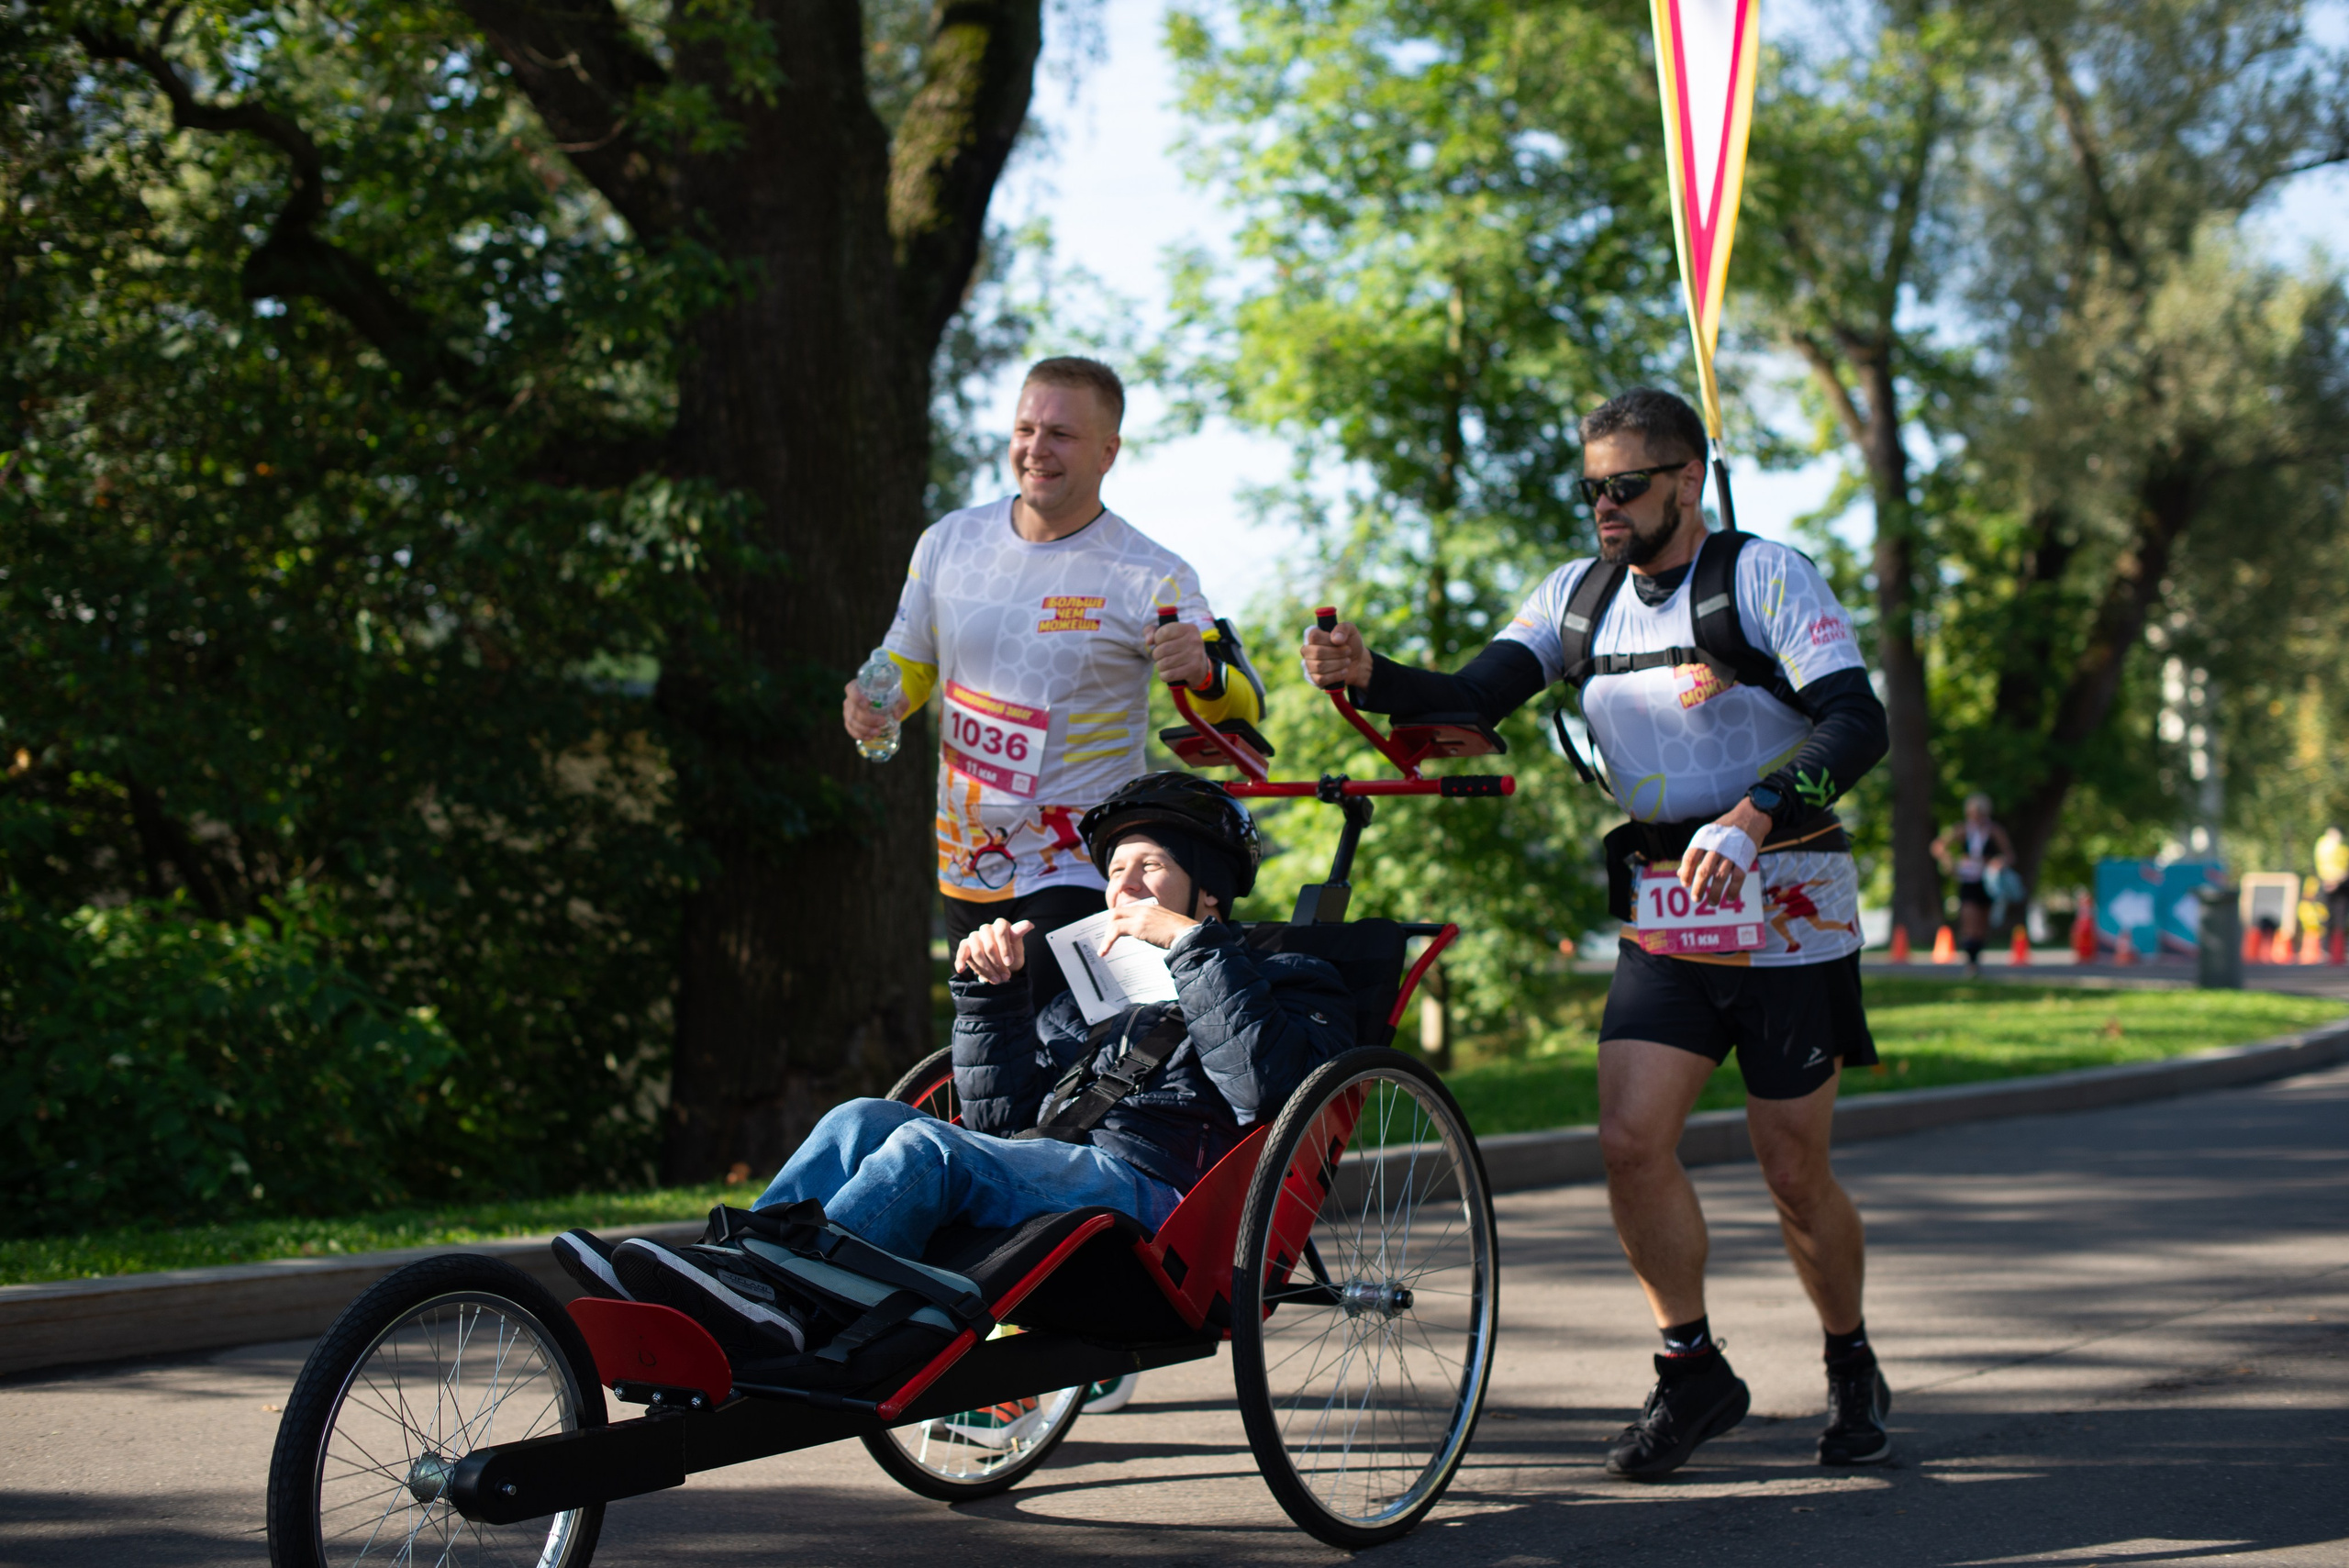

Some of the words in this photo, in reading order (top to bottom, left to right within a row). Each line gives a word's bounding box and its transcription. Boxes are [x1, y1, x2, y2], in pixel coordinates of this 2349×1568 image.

[1048, 596, 1105, 608] БОЛЬШЕ
[1056, 607, 1085, 618] ЧЕМ
[1039, 619, 1099, 632] МОЖЕШЬ
[1694, 667, 1716, 684] ЧЕ
[952, 711, 1029, 762] 1036
[966, 761, 978, 776] 11
[1650, 885, 1745, 918] 1024
[1680, 932, 1695, 947] 11
